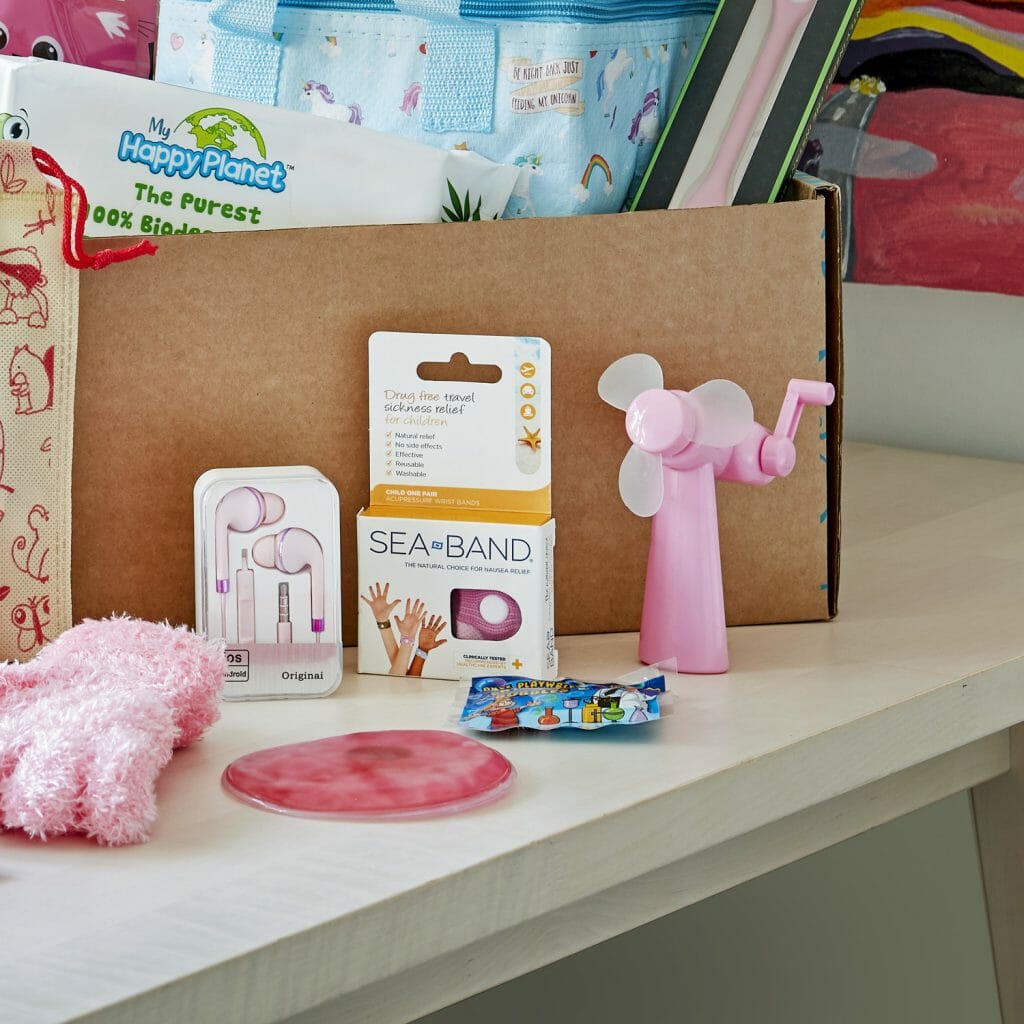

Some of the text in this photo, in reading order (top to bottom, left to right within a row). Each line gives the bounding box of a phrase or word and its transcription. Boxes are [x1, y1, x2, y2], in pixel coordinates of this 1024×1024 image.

[563, 60, 579, 75] JUST
[538, 96, 548, 108] MY
[148, 116, 170, 140] My
[121, 133, 286, 190] Happy Planet
[135, 182, 173, 206] The
[180, 191, 262, 225] Purest
[85, 203, 133, 230] 00%
[384, 389, 476, 404] Drug free travel
[384, 403, 466, 415] sickness relief
[384, 415, 448, 427] for children
[395, 432, 418, 440] Natural
[420, 442, 443, 450] effects
[395, 451, 424, 459] Effective
[395, 470, 427, 478] Washable
[369, 530, 532, 562] SEA BAND
[417, 562, 444, 570] NATURAL
